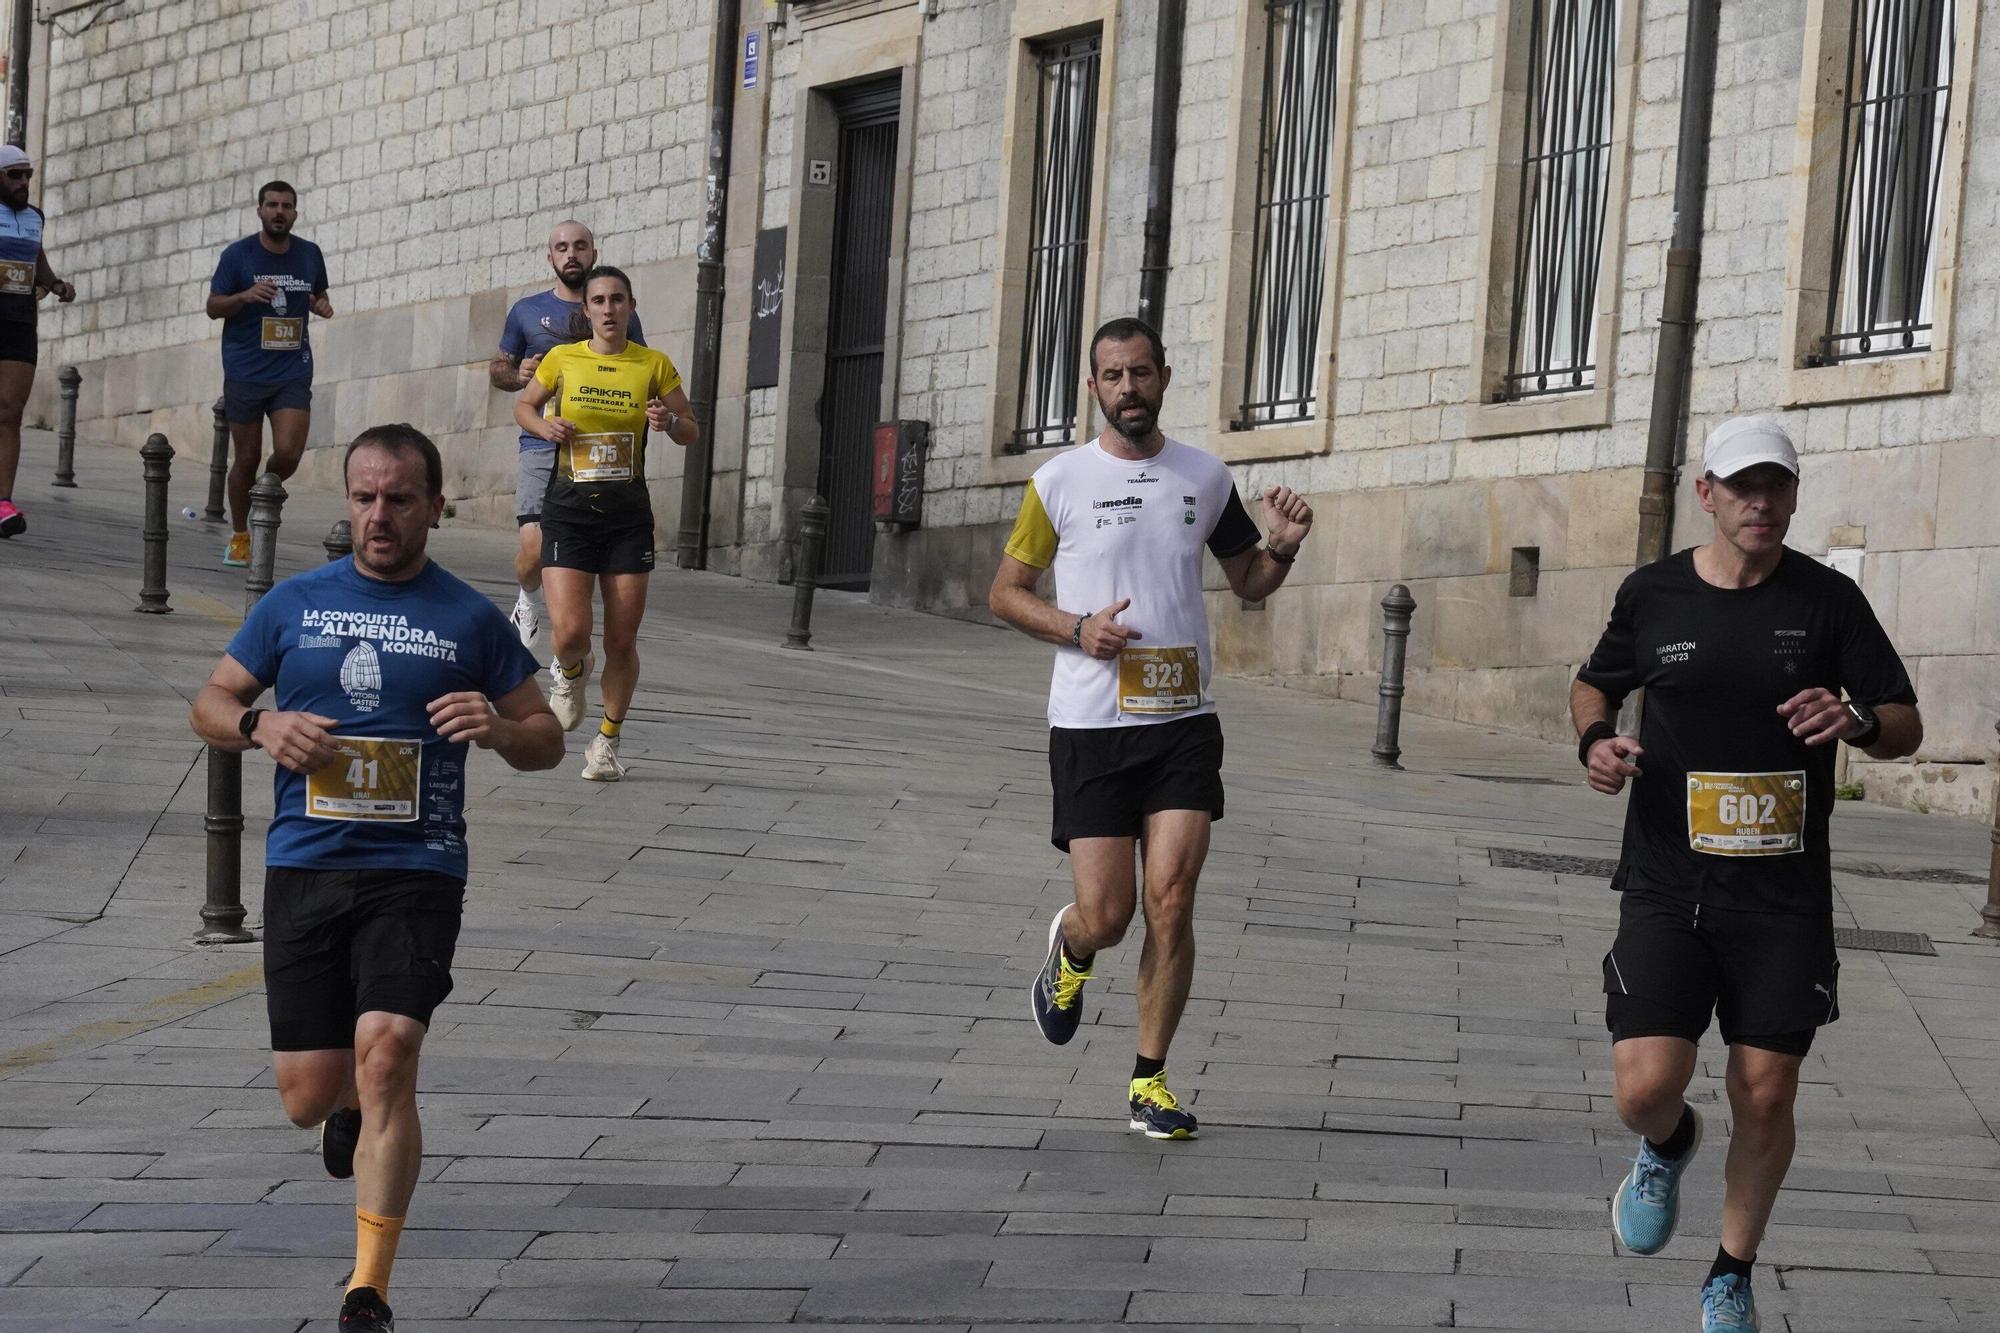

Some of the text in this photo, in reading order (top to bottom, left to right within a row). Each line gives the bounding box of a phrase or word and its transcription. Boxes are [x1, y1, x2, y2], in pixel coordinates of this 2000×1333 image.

[275, 326, 294, 338] 574
[580, 386, 631, 399] GAIKAR
[589, 445, 617, 463] 475
[303, 609, 408, 626] LA CONQUISTA
[321, 621, 438, 645] ALMENDRA
[439, 639, 457, 650] REN
[382, 641, 456, 662] KONKISTA
[1656, 641, 1696, 655] MARATÓN
[1661, 652, 1689, 665] BCN'23
[1142, 662, 1183, 688] 323
[350, 698, 380, 707] GASTEIZ
[351, 691, 380, 700] VITORIA
[346, 759, 378, 789] 41
[1719, 794, 1776, 824] 602
[1736, 827, 1760, 835] RUBEN
